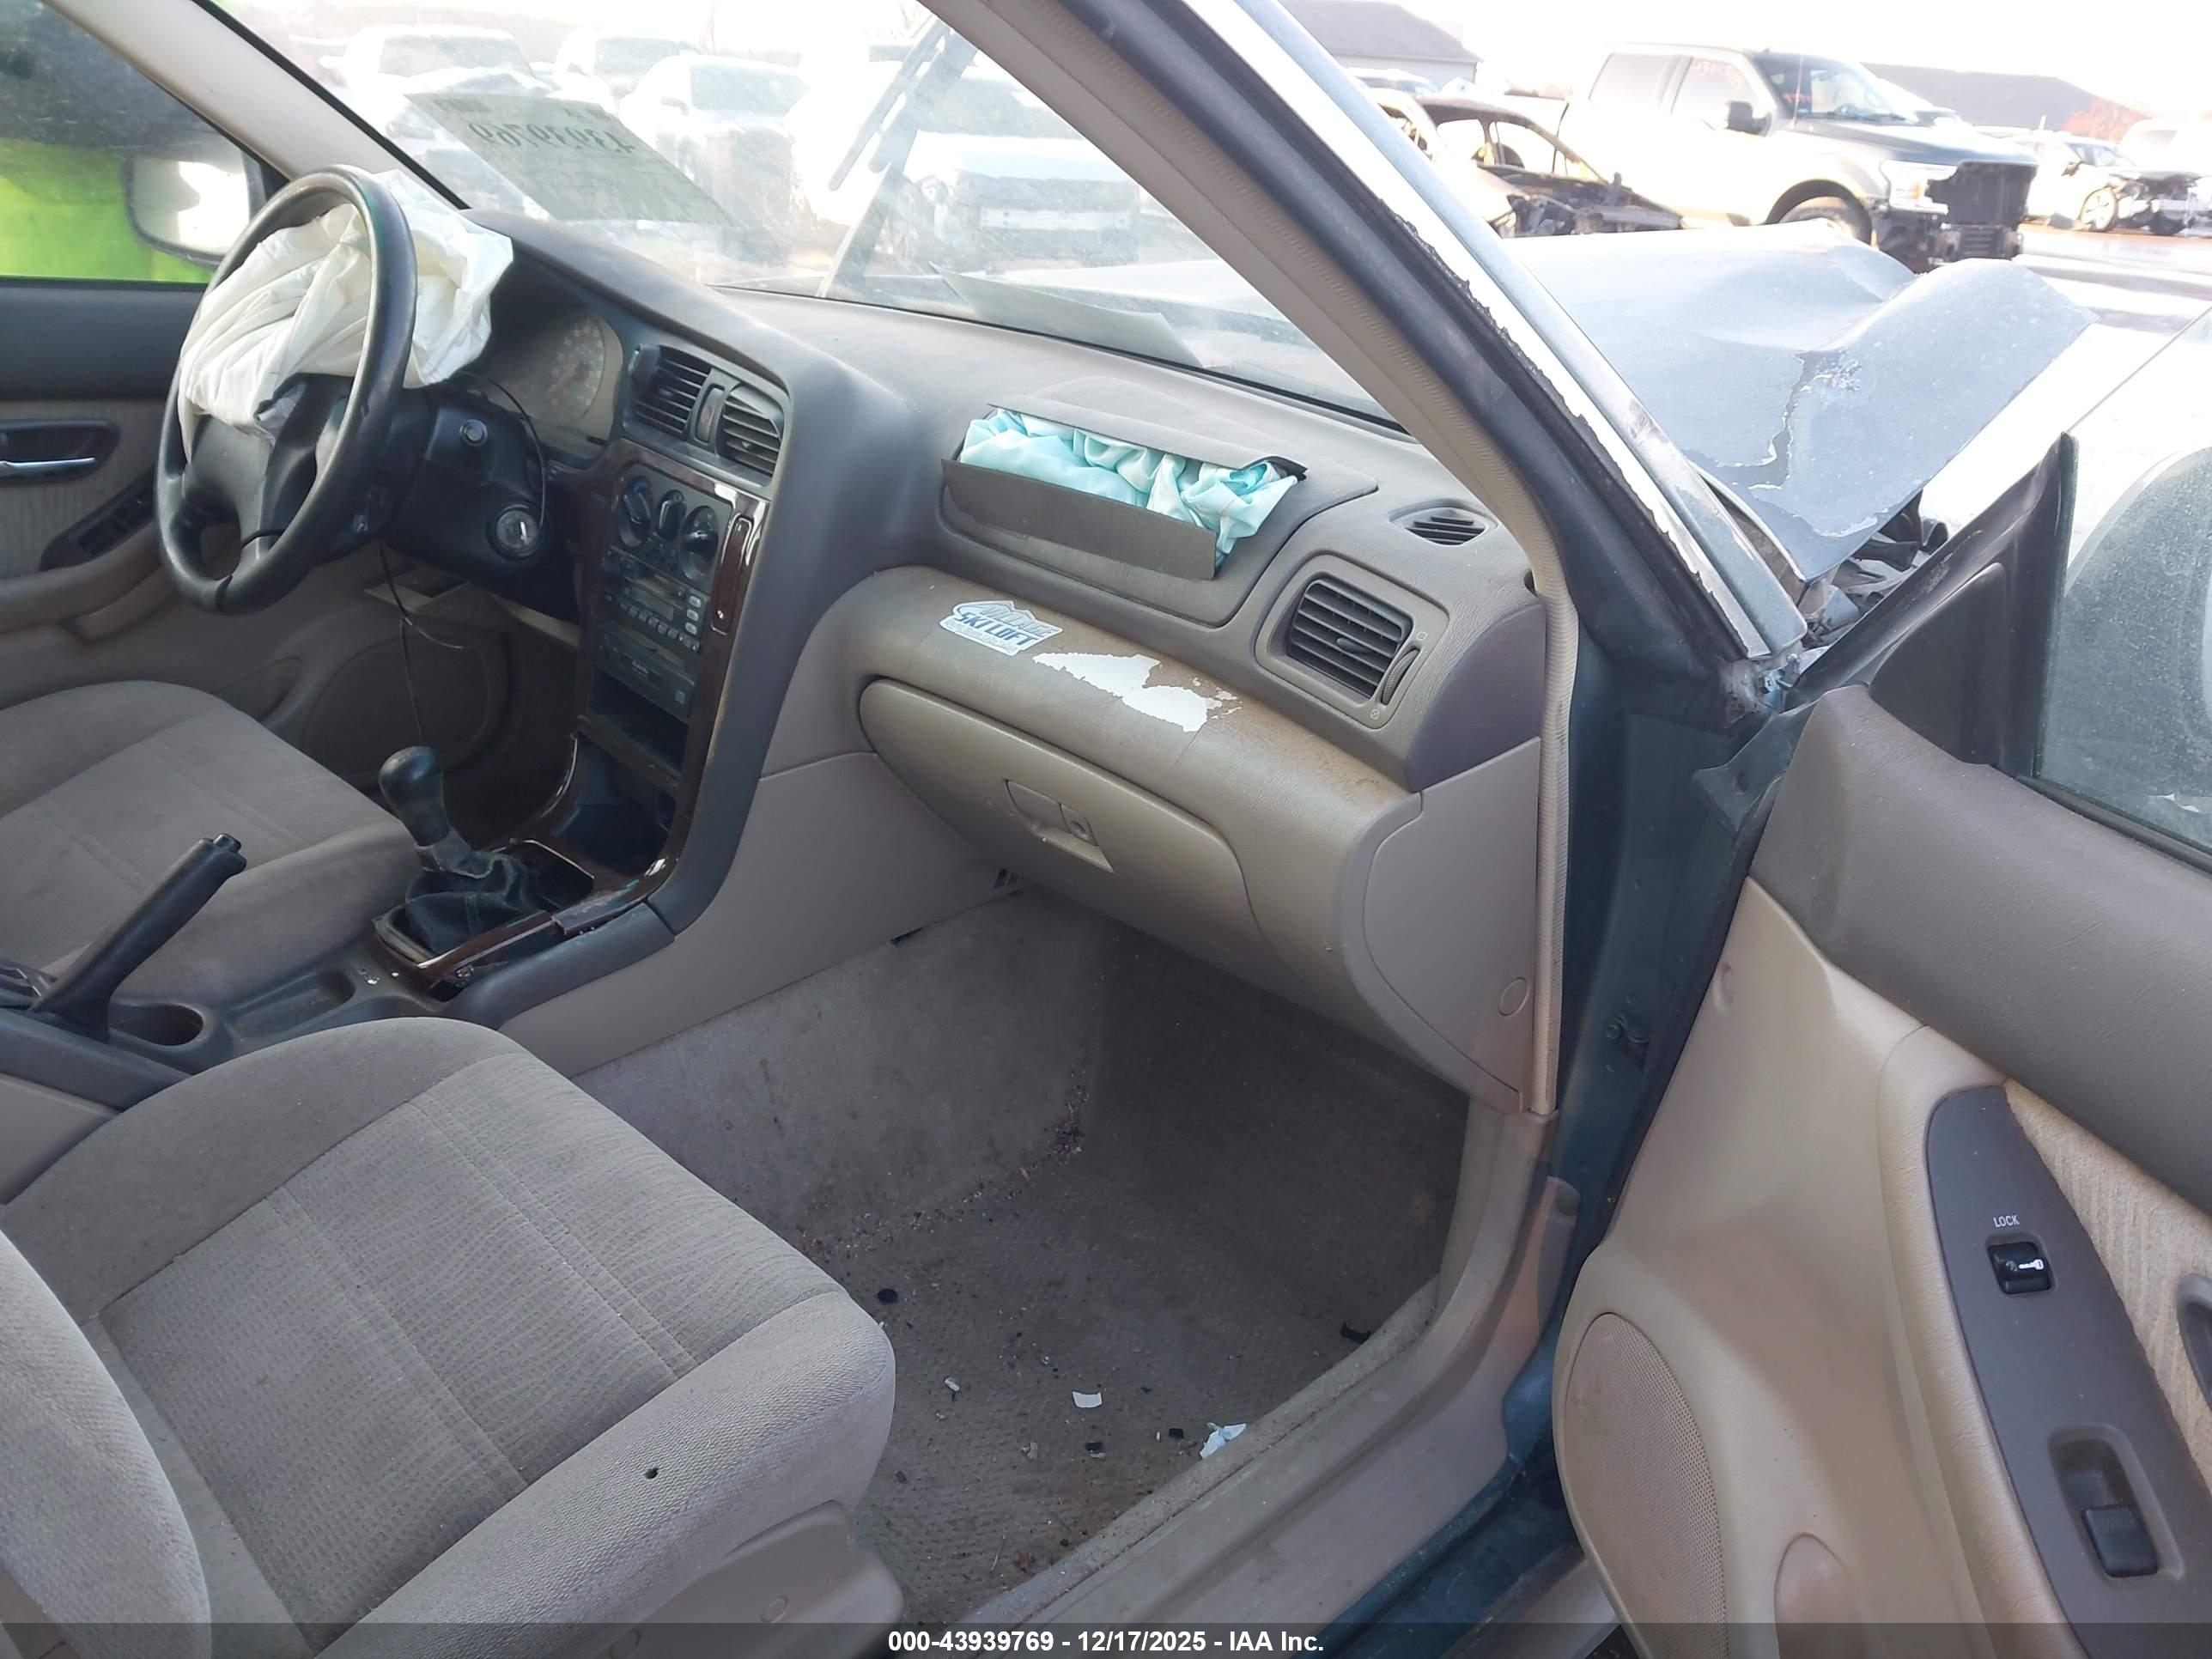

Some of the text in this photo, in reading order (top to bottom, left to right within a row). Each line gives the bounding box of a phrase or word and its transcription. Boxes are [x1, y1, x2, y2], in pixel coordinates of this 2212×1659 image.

[953, 611, 994, 629] SKI
[983, 623, 1038, 646] LOFT
[1993, 1214, 2020, 1228] LOCK
